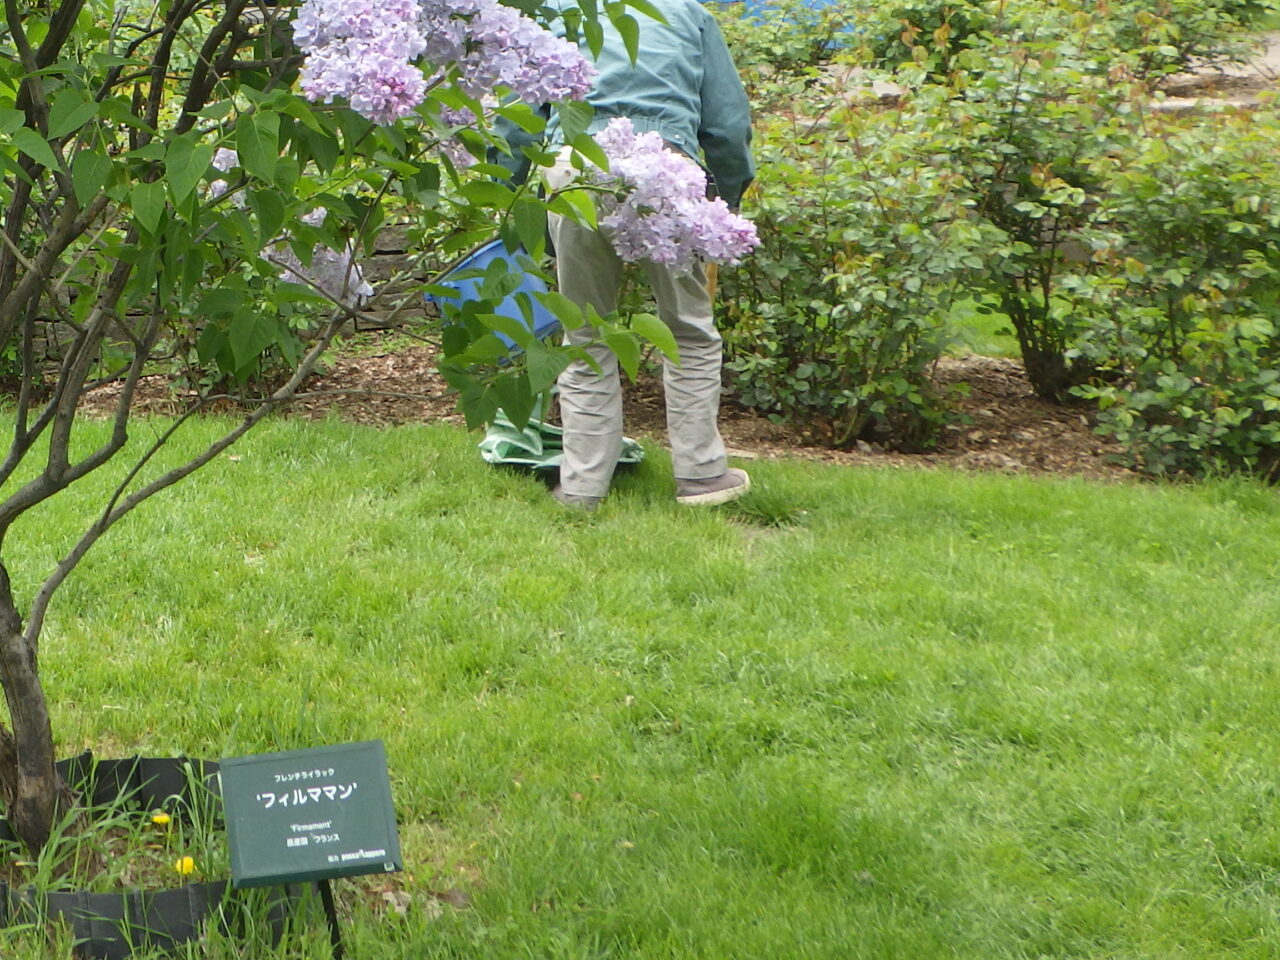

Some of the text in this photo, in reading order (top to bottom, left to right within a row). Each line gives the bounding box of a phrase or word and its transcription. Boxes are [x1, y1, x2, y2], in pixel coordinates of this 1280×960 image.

[274, 768, 335, 782] フレンチライラック
